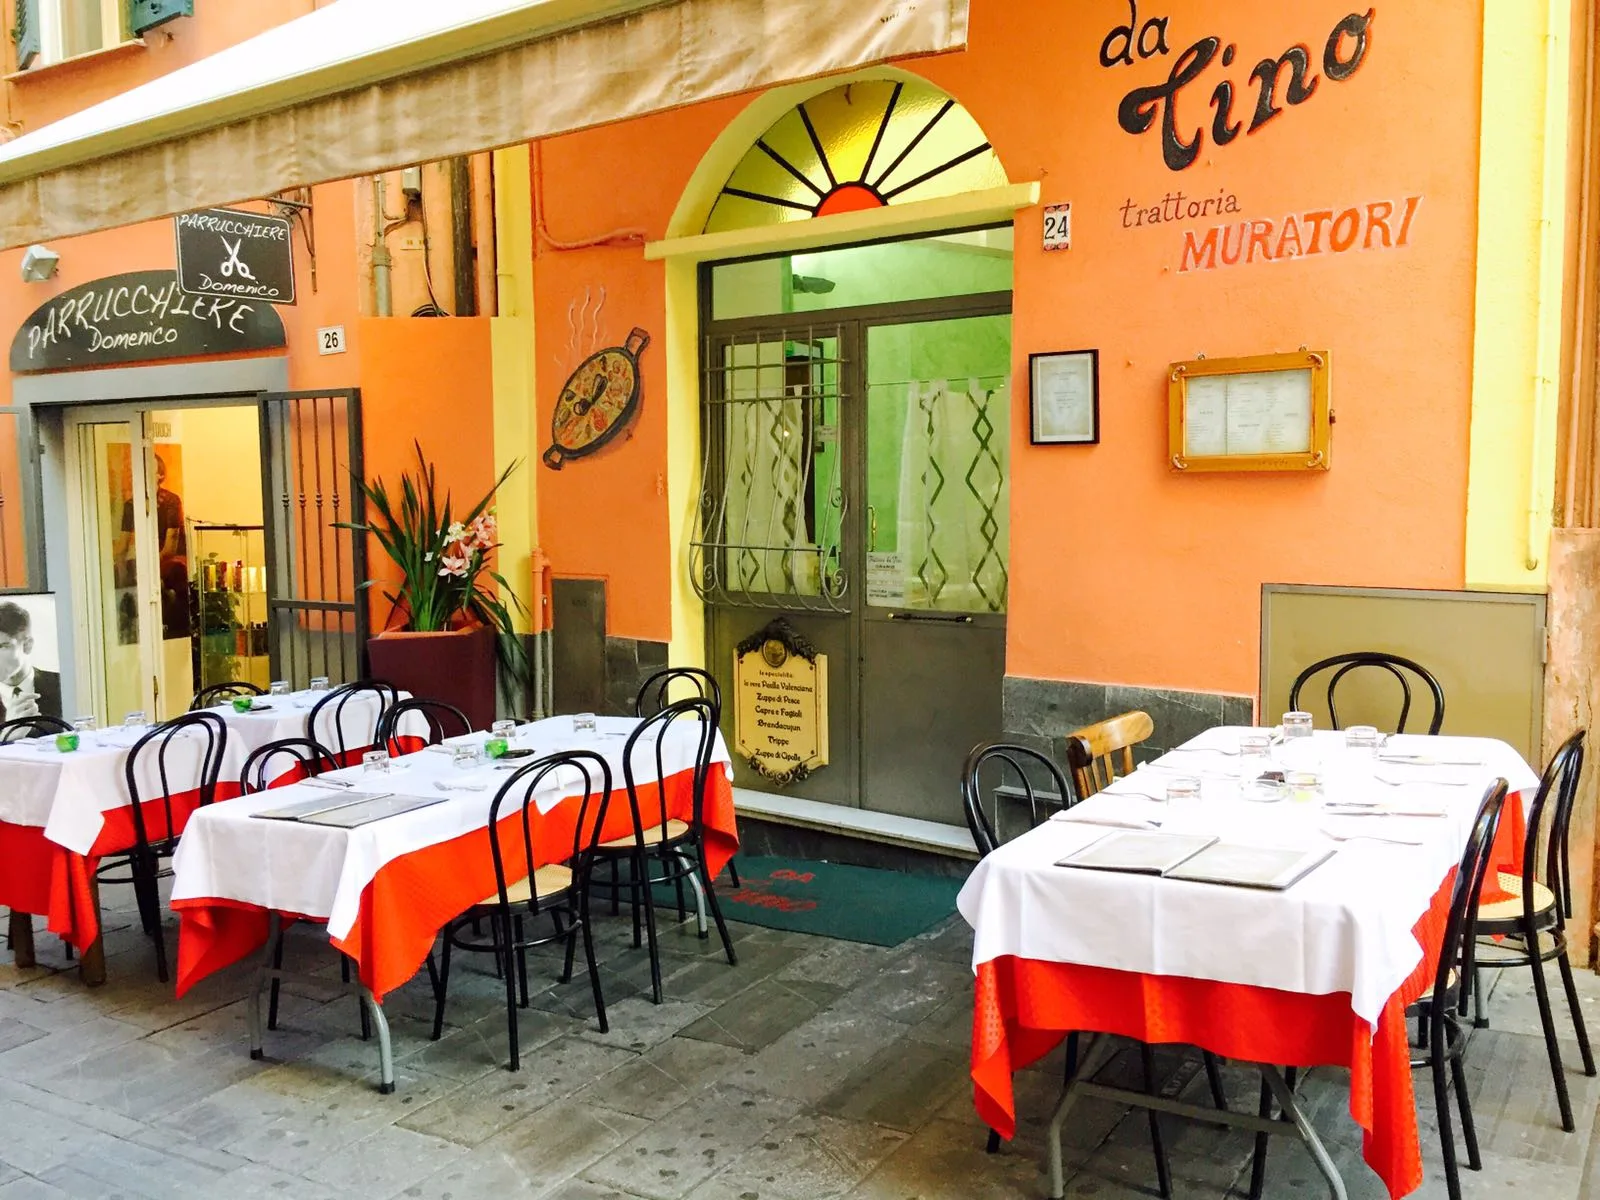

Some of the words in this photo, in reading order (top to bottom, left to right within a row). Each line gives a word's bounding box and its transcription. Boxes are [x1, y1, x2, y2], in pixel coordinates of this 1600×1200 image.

[1099, 0, 1171, 68] da
[1117, 7, 1376, 172] Tino
[1119, 188, 1242, 228] trattoria
[180, 213, 287, 242] PARRUCCHIERE
[1044, 214, 1069, 240] 24
[1177, 196, 1424, 274] MURATORI
[198, 273, 279, 297] Domenico
[28, 281, 254, 359] PARRUCCHIERE
[88, 322, 178, 353] Domenico
[323, 331, 340, 350] 26
